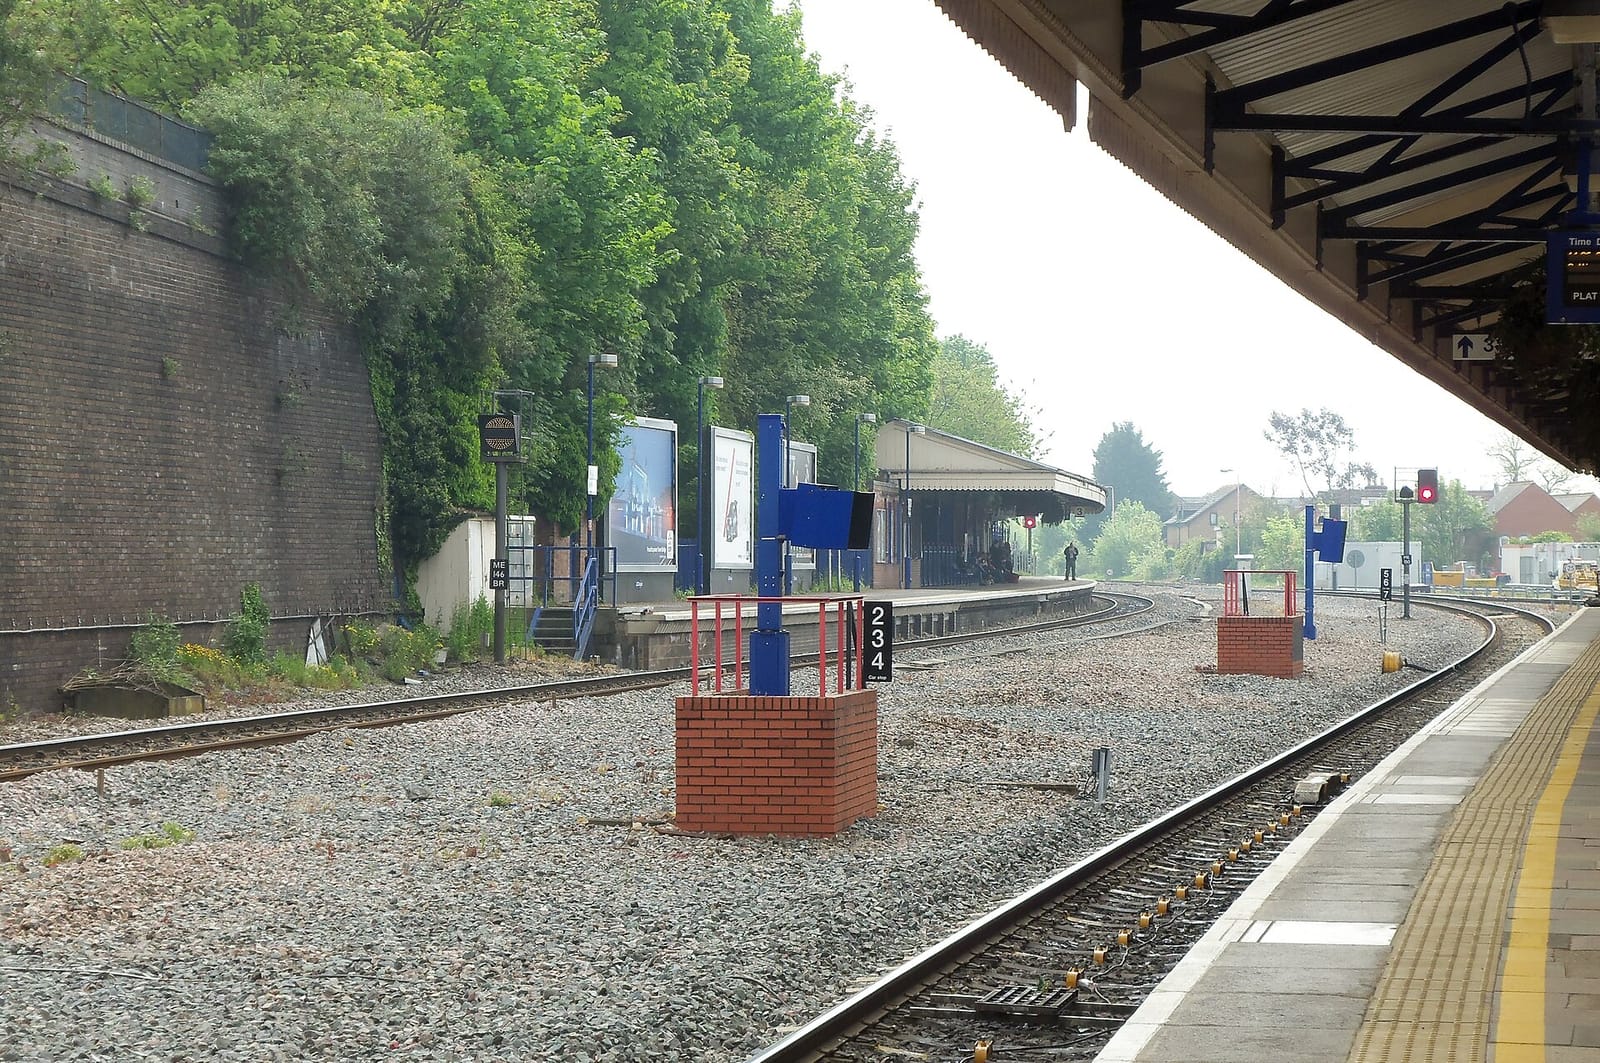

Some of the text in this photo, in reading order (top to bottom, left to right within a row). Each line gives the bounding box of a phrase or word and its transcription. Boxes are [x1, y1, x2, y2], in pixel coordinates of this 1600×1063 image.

[1568, 237, 1591, 246] Time
[1573, 292, 1598, 300] PLAT
[493, 561, 506, 569] ME
[1383, 570, 1389, 578] 5
[493, 579, 505, 587] BR
[1383, 578, 1389, 586] 6
[1383, 590, 1389, 598] 7
[871, 606, 885, 625] 2
[871, 629, 885, 648] 3
[871, 652, 885, 670] 4
